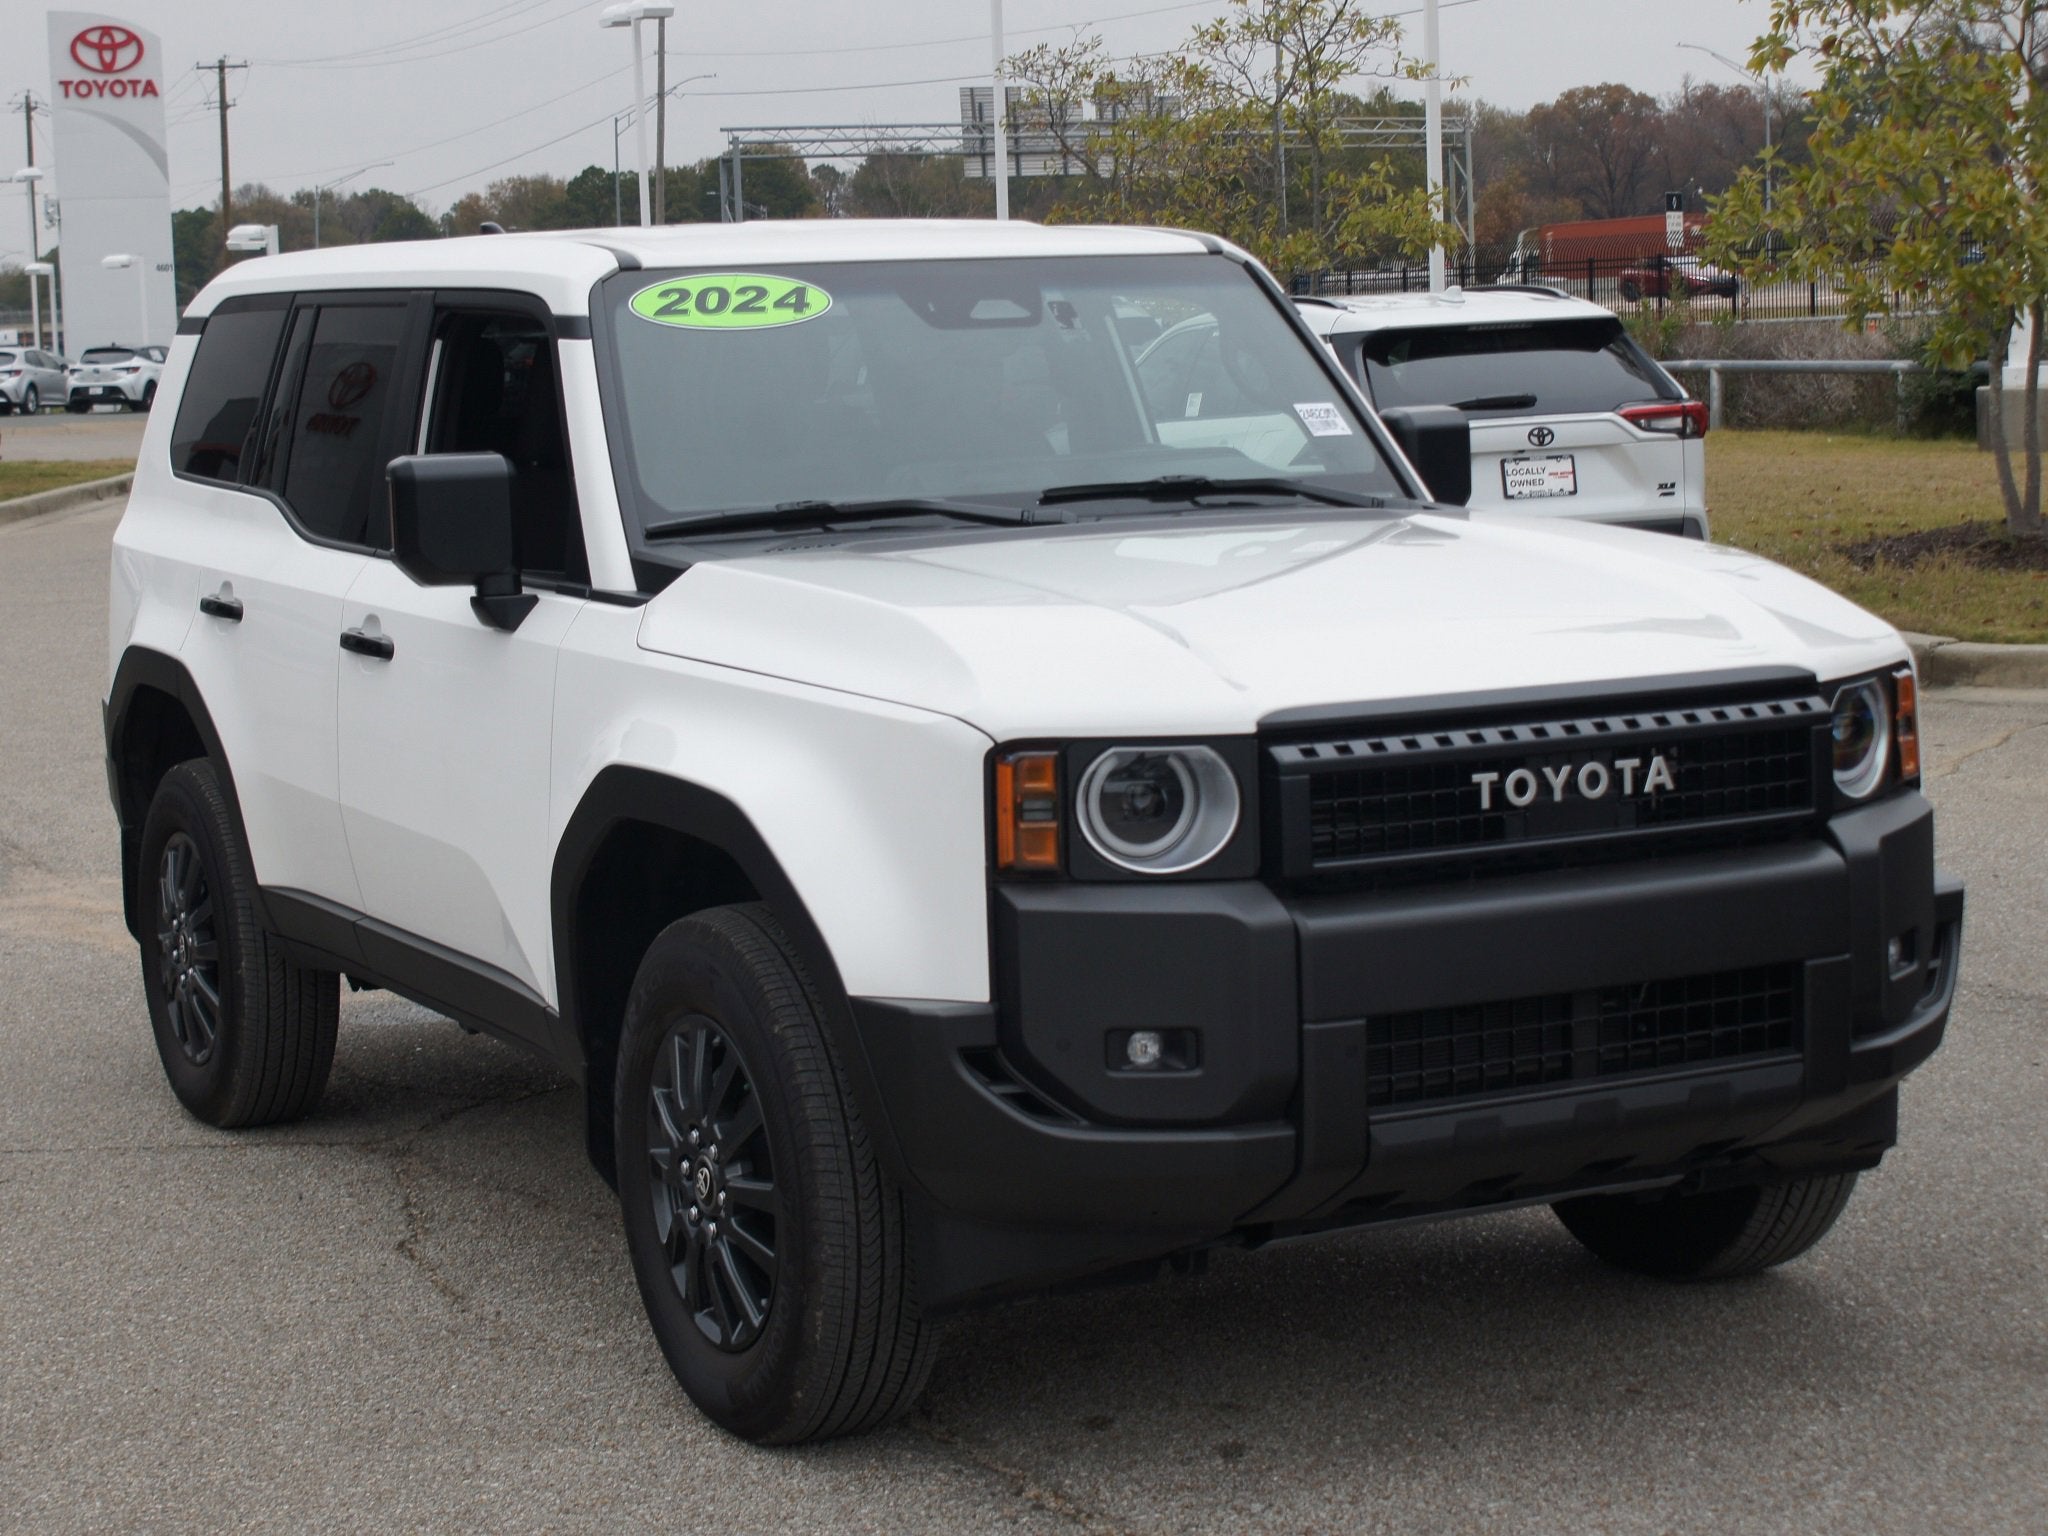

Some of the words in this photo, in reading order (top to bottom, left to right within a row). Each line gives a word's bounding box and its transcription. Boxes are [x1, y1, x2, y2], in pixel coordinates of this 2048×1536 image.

[58, 79, 159, 98] TOYOTA
[652, 285, 812, 317] 2024
[1506, 467, 1546, 477] LOCALLY
[1510, 479, 1545, 488] OWNED
[1471, 755, 1674, 810] TOYOTA
